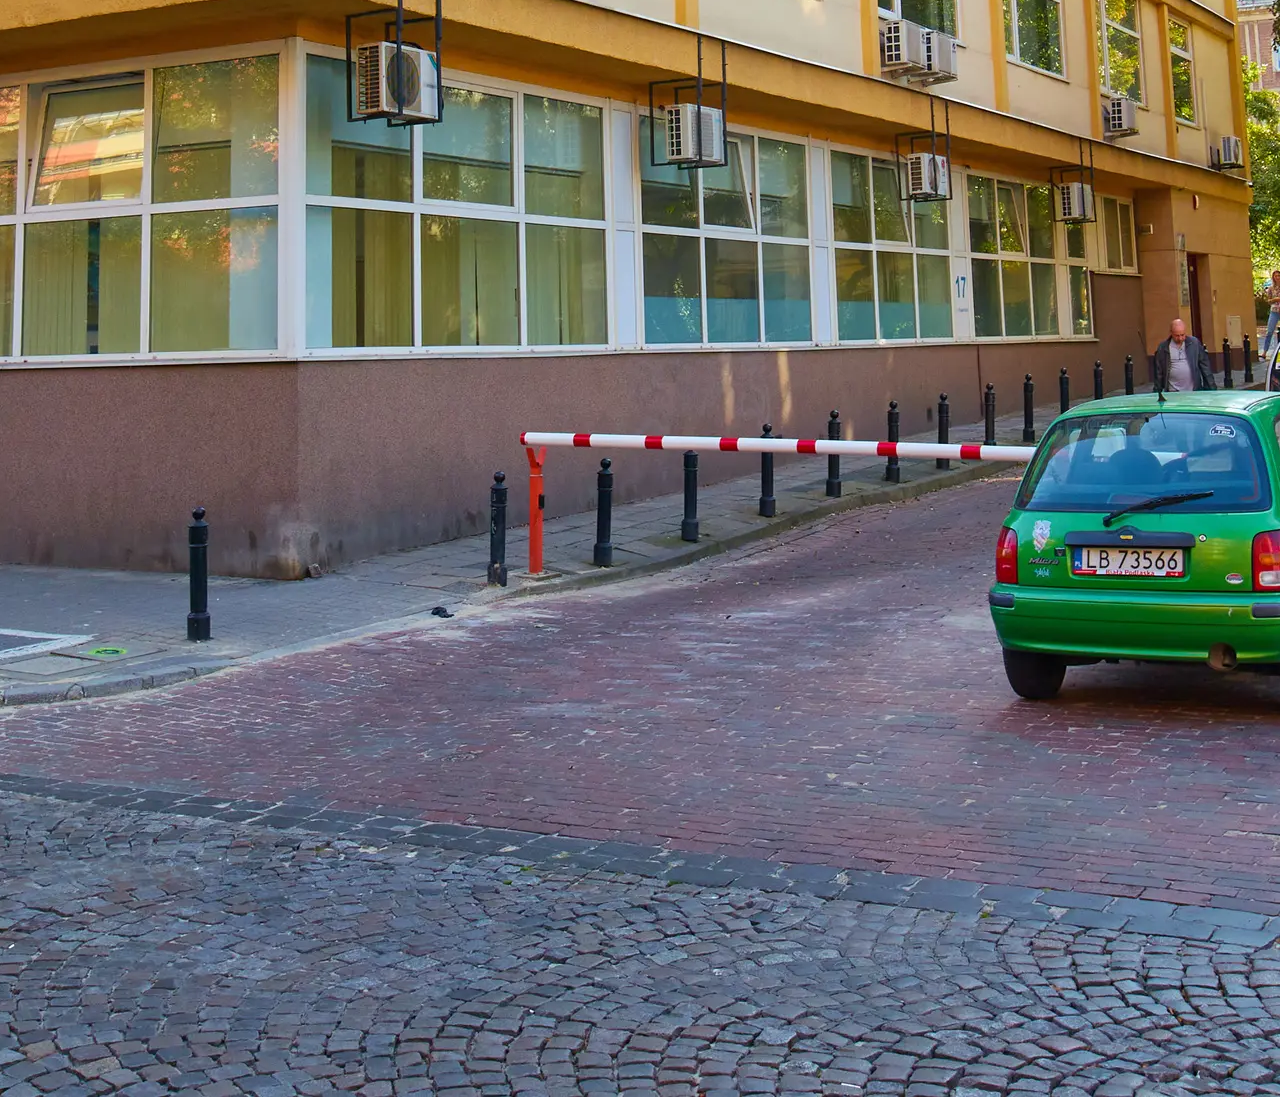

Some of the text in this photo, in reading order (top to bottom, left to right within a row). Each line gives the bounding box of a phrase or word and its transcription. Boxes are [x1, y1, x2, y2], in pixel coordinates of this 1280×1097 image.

[955, 275, 966, 299] 17
[1028, 557, 1061, 566] Micra
[1086, 549, 1179, 571] LB 73566
